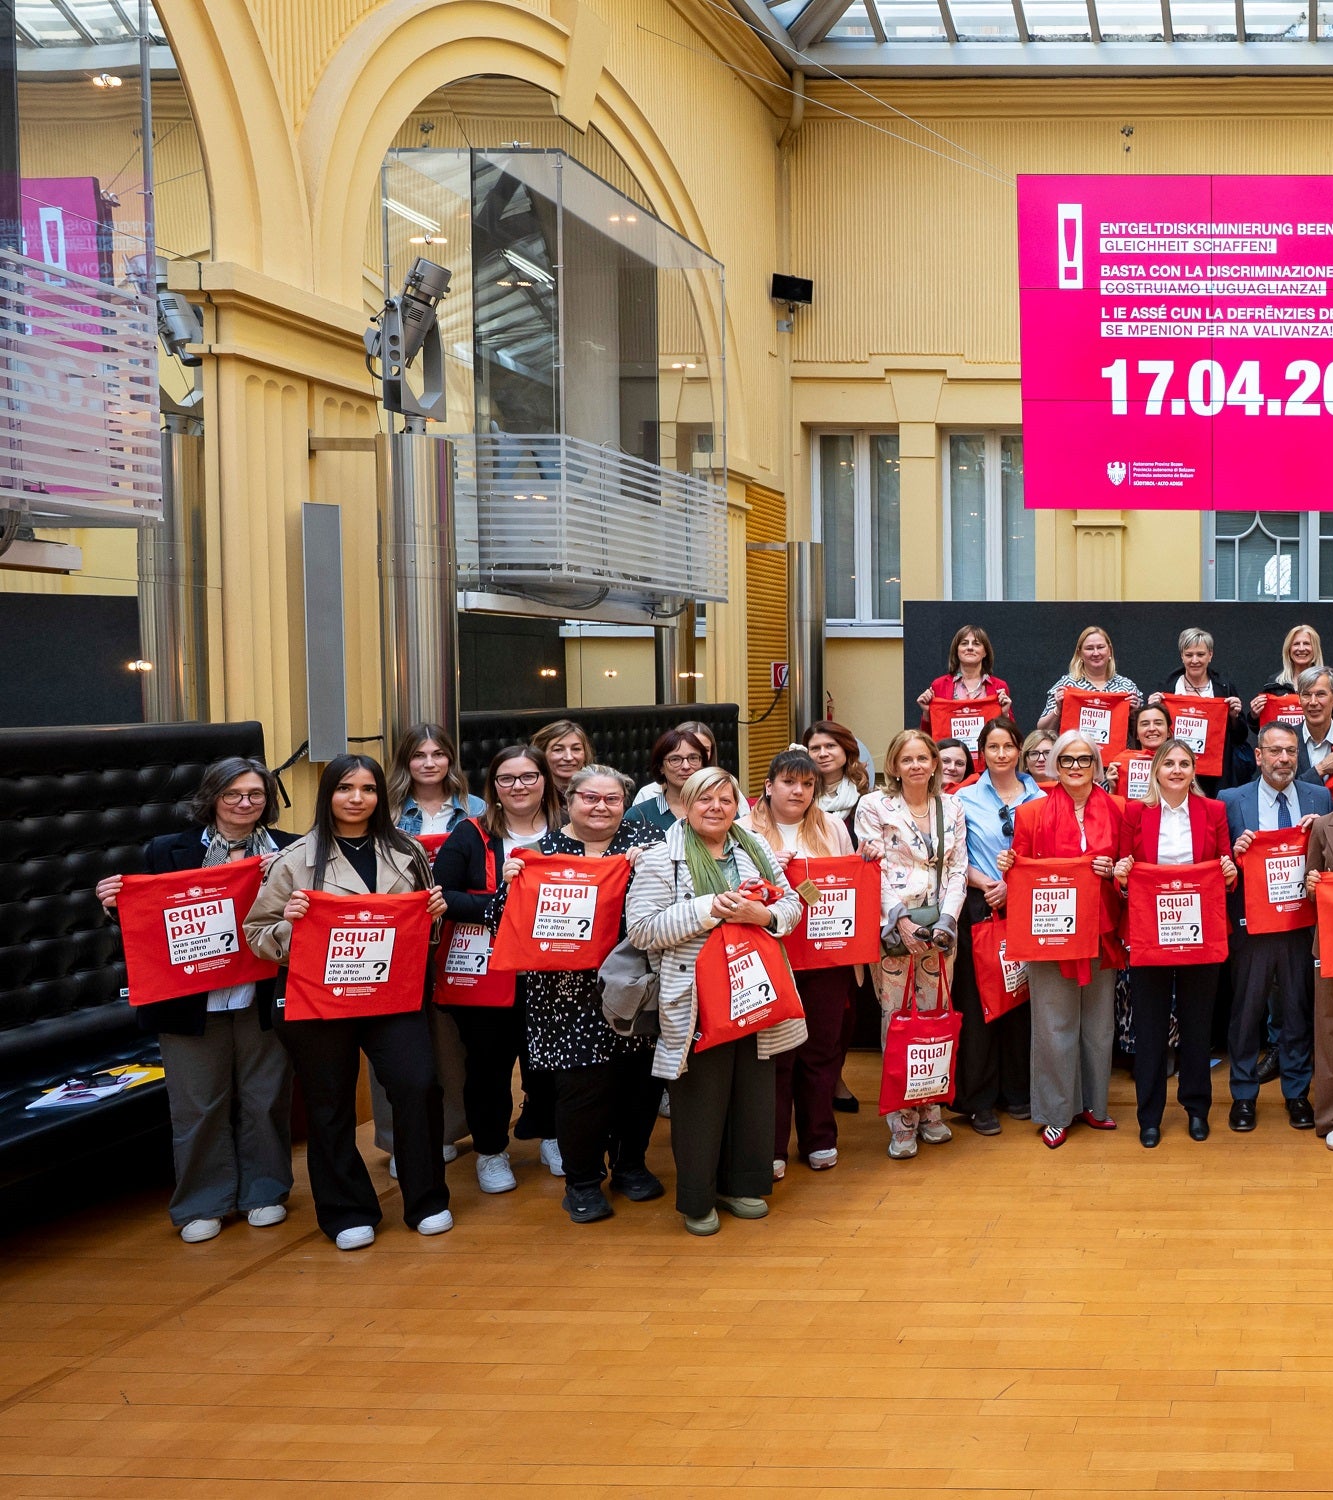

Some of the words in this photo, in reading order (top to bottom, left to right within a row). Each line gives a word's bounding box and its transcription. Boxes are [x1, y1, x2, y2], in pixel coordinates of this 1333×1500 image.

[1100, 223, 1293, 236] ENTGELTDISKRIMINIERUNG
[1104, 240, 1189, 252] GLEICHHEIT
[1193, 240, 1272, 252] SCHAFFEN!
[1101, 265, 1145, 278] BASTA
[1149, 266, 1181, 278] CON
[1185, 266, 1203, 278] LA
[1105, 283, 1201, 294] COSTRUIAMO
[1205, 283, 1322, 295] L'UGUAGLIANZA!
[1101, 307, 1110, 319] L
[1113, 307, 1127, 319] IE
[1130, 304, 1167, 320] ASSÉ
[1170, 308, 1201, 320] CUN
[1205, 308, 1224, 320] LA
[1227, 305, 1316, 320] DEFRËNZIES
[1106, 324, 1122, 336] SE
[1127, 324, 1193, 336] MPENION
[1229, 325, 1249, 336] NA
[1253, 325, 1333, 337] VALIVANZA!
[1082, 709, 1106, 718] equal
[952, 717, 979, 728] equal
[1081, 717, 1097, 727] pay
[1177, 718, 1202, 727] equal
[952, 728, 970, 738] pay
[1175, 726, 1193, 737] pay
[1131, 761, 1151, 771] equ
[1130, 771, 1149, 782] pay
[1268, 856, 1300, 871] equal
[1269, 871, 1289, 884] pay
[542, 886, 588, 900] equal
[819, 890, 847, 904] qual
[1034, 889, 1069, 902] equal
[540, 900, 570, 915] pay
[1034, 903, 1057, 914] pay
[1159, 895, 1193, 909] equal
[168, 901, 222, 922] equal
[810, 905, 834, 918] pay
[1159, 910, 1182, 923] pay
[170, 921, 205, 940] pay
[333, 929, 384, 945] equal
[455, 925, 485, 937] equal
[190, 936, 210, 945] sonst
[450, 938, 471, 951] pay
[187, 952, 198, 960] pa
[331, 946, 365, 959] pay
[910, 1043, 947, 1062] equal
[910, 1062, 935, 1078] pay
